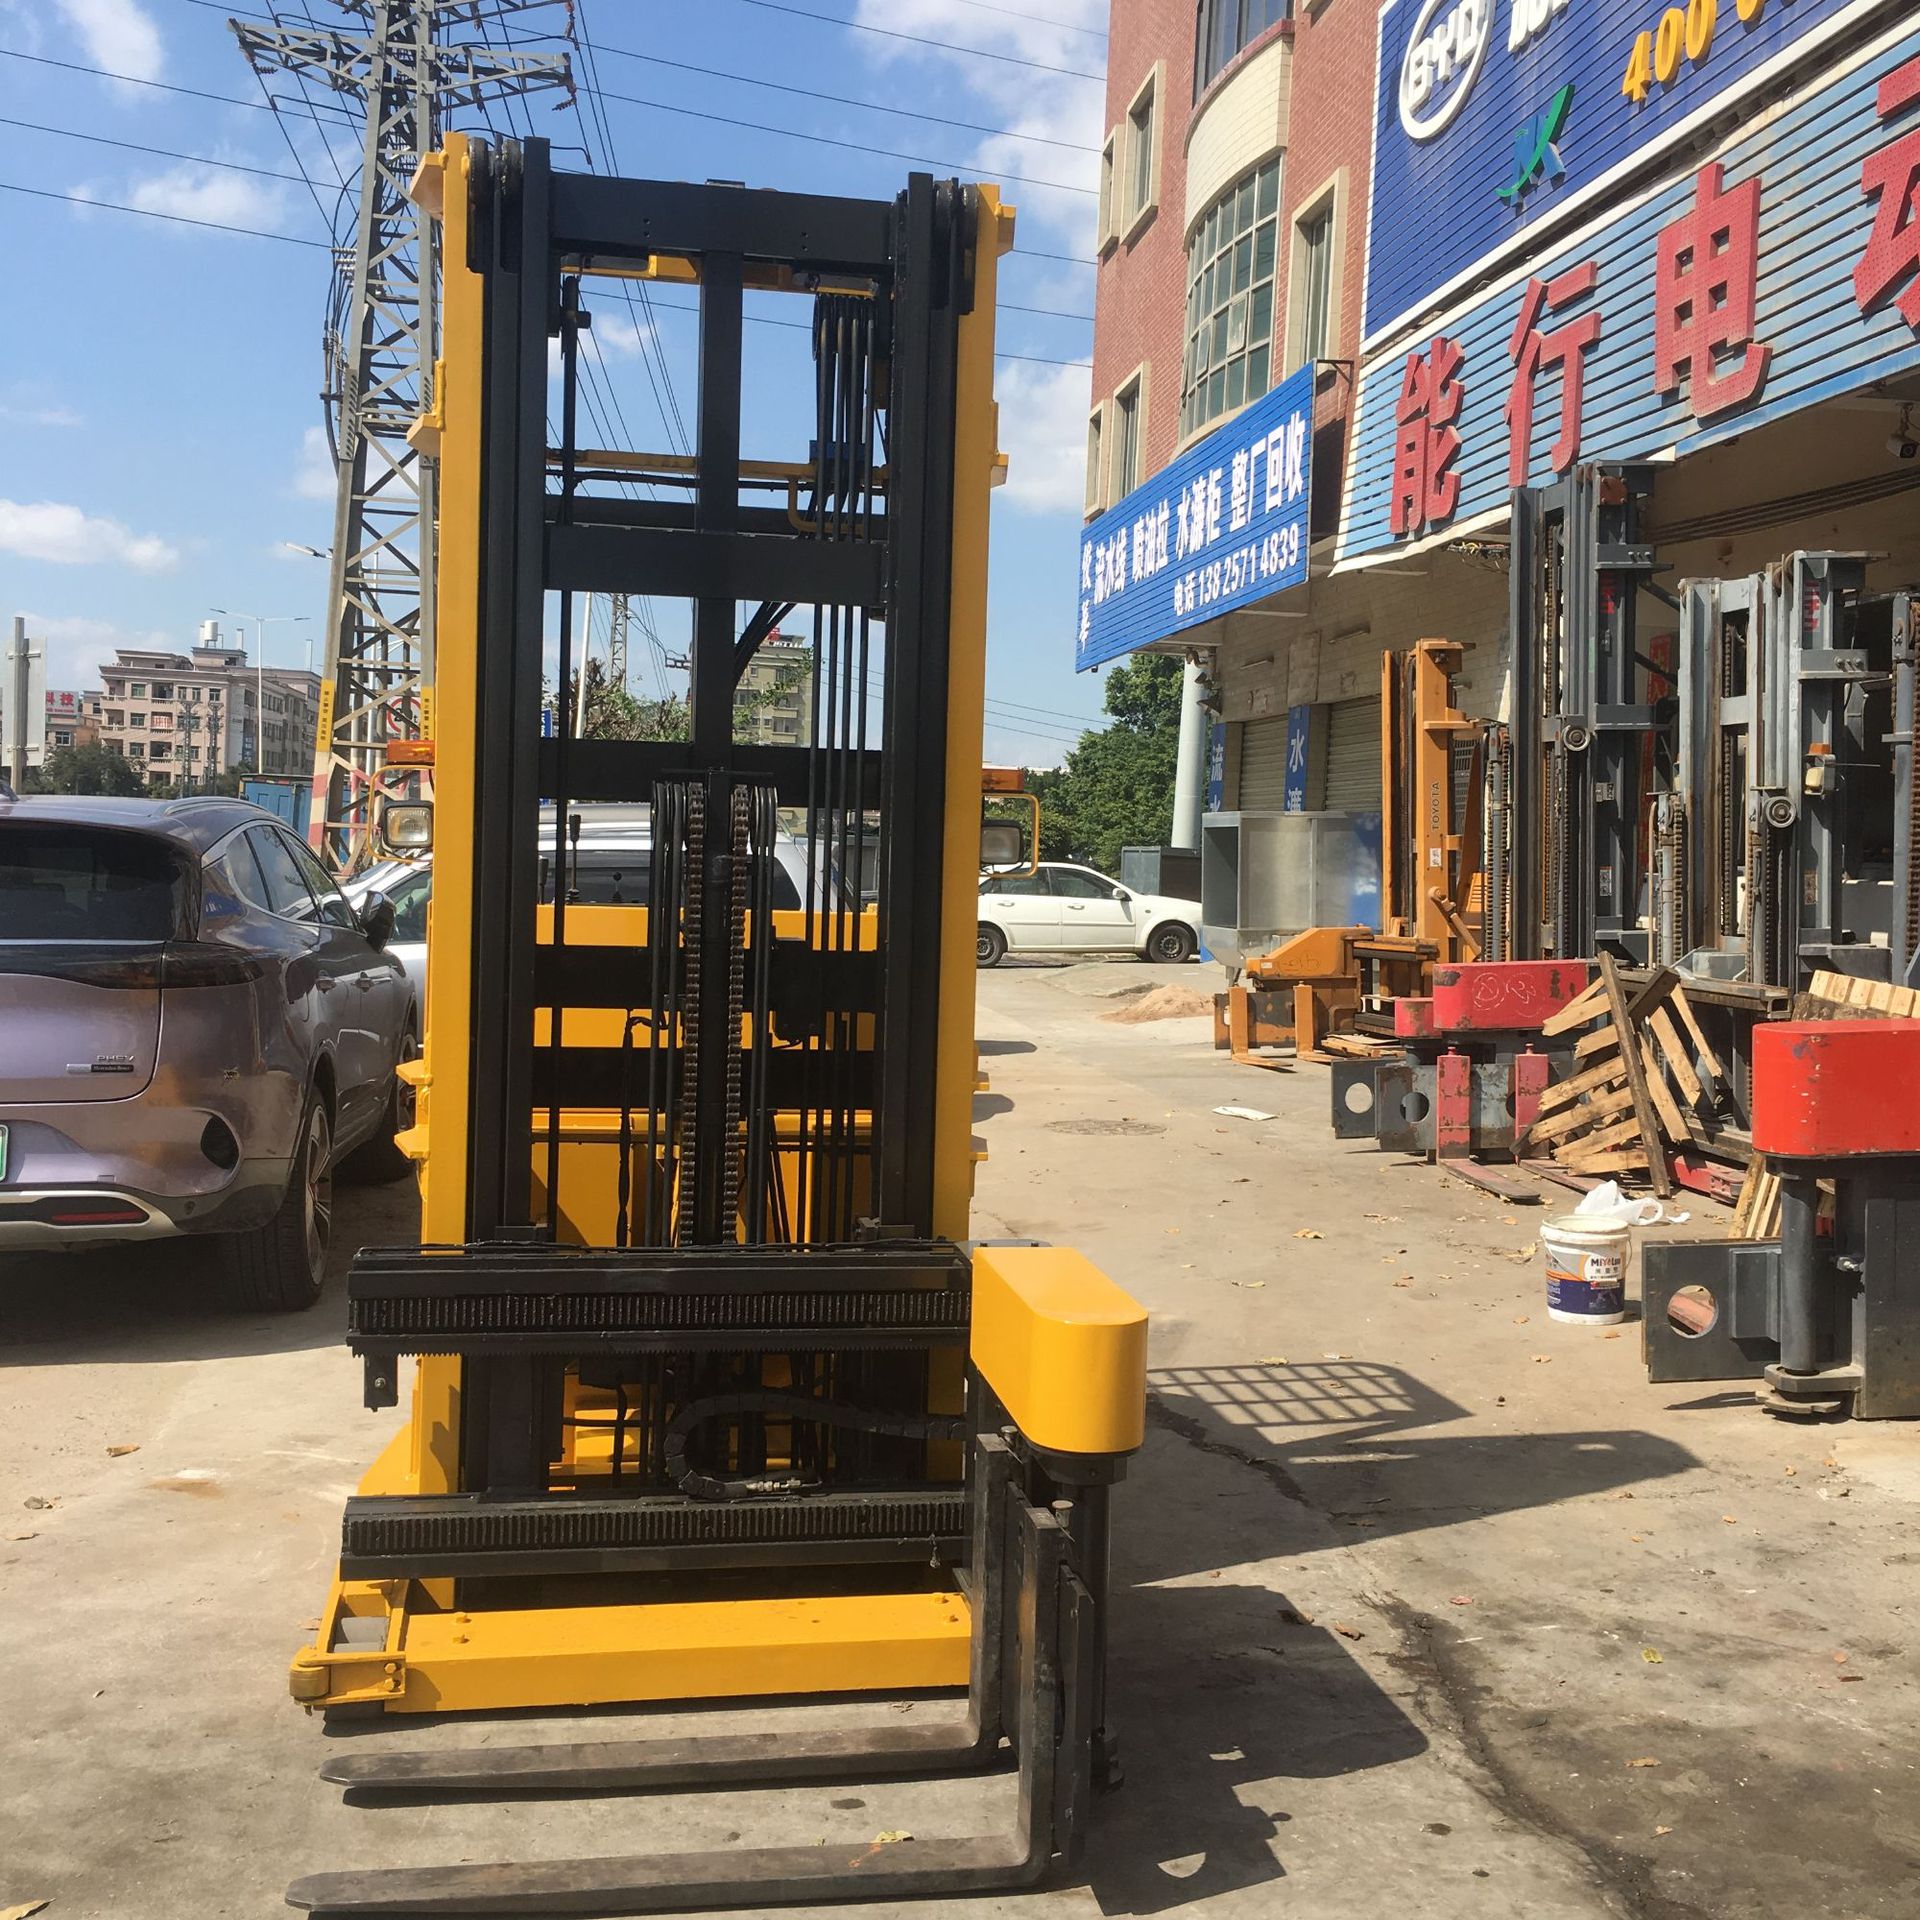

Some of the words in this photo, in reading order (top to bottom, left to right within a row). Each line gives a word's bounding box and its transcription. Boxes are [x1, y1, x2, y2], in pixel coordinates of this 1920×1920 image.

[1408, 0, 1482, 117] BYD
[1229, 410, 1305, 533] 整厂回收
[1431, 782, 1441, 831] TOYOTA
